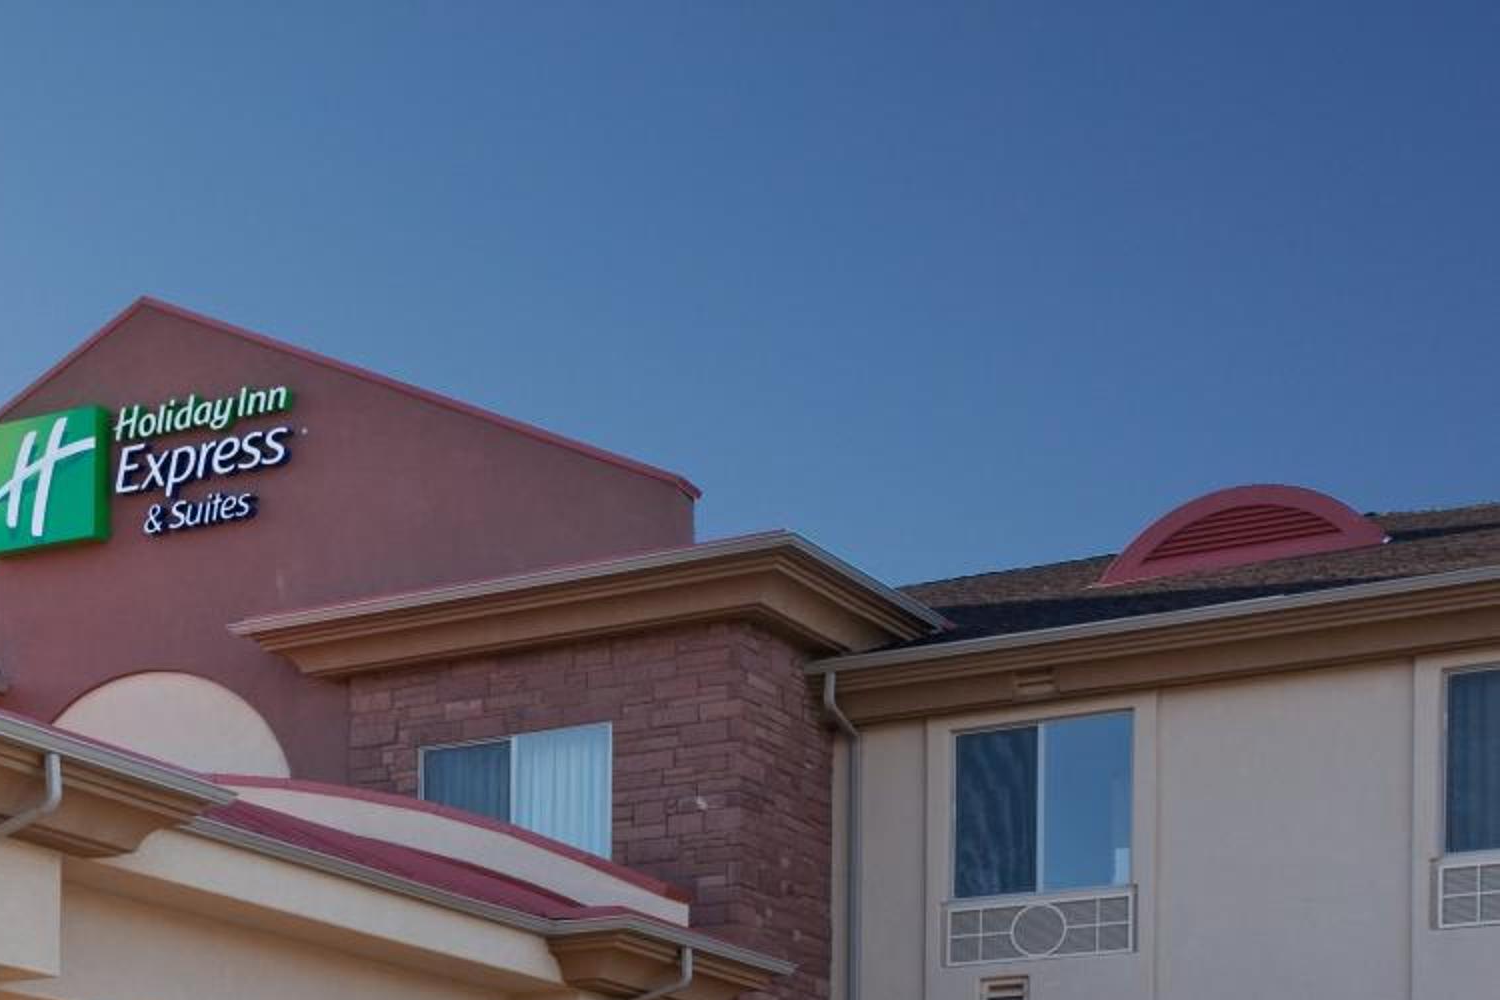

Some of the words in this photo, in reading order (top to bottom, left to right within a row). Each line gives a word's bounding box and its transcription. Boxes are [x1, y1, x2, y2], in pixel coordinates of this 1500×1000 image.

[113, 394, 233, 441] Holiday
[238, 386, 287, 417] Inn
[115, 427, 288, 497] Express
[144, 503, 164, 533] &
[169, 493, 251, 529] Suites
